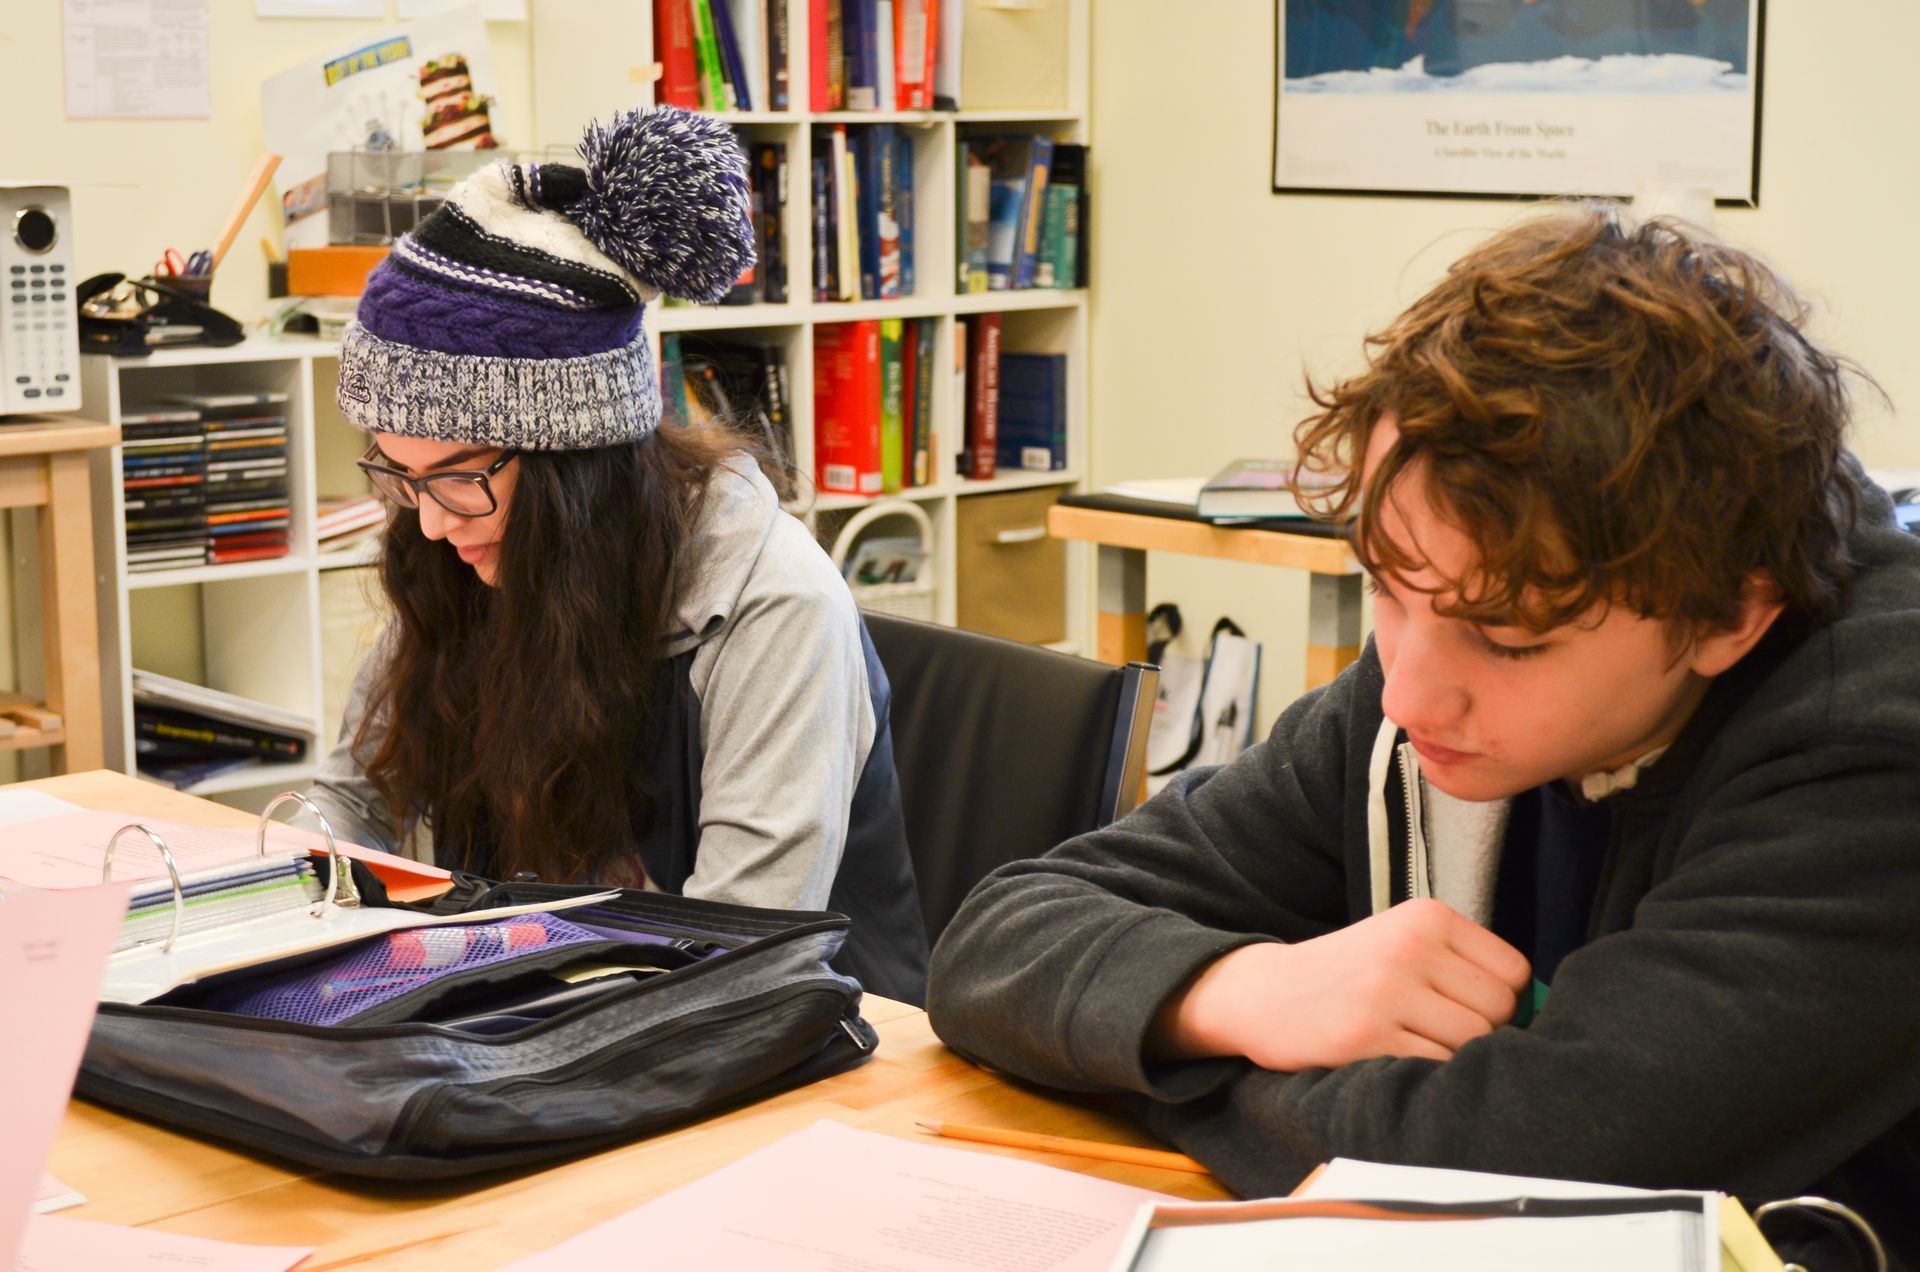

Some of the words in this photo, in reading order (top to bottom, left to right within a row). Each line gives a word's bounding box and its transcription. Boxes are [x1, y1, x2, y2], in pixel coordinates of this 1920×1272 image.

[1425, 121, 1449, 136] The
[1453, 121, 1491, 136] Earth
[1495, 121, 1532, 136] From
[1535, 121, 1576, 141] Space
[1481, 148, 1503, 158] View
[1505, 148, 1517, 159] of
[1520, 148, 1533, 159] the
[1536, 149, 1567, 159] World
